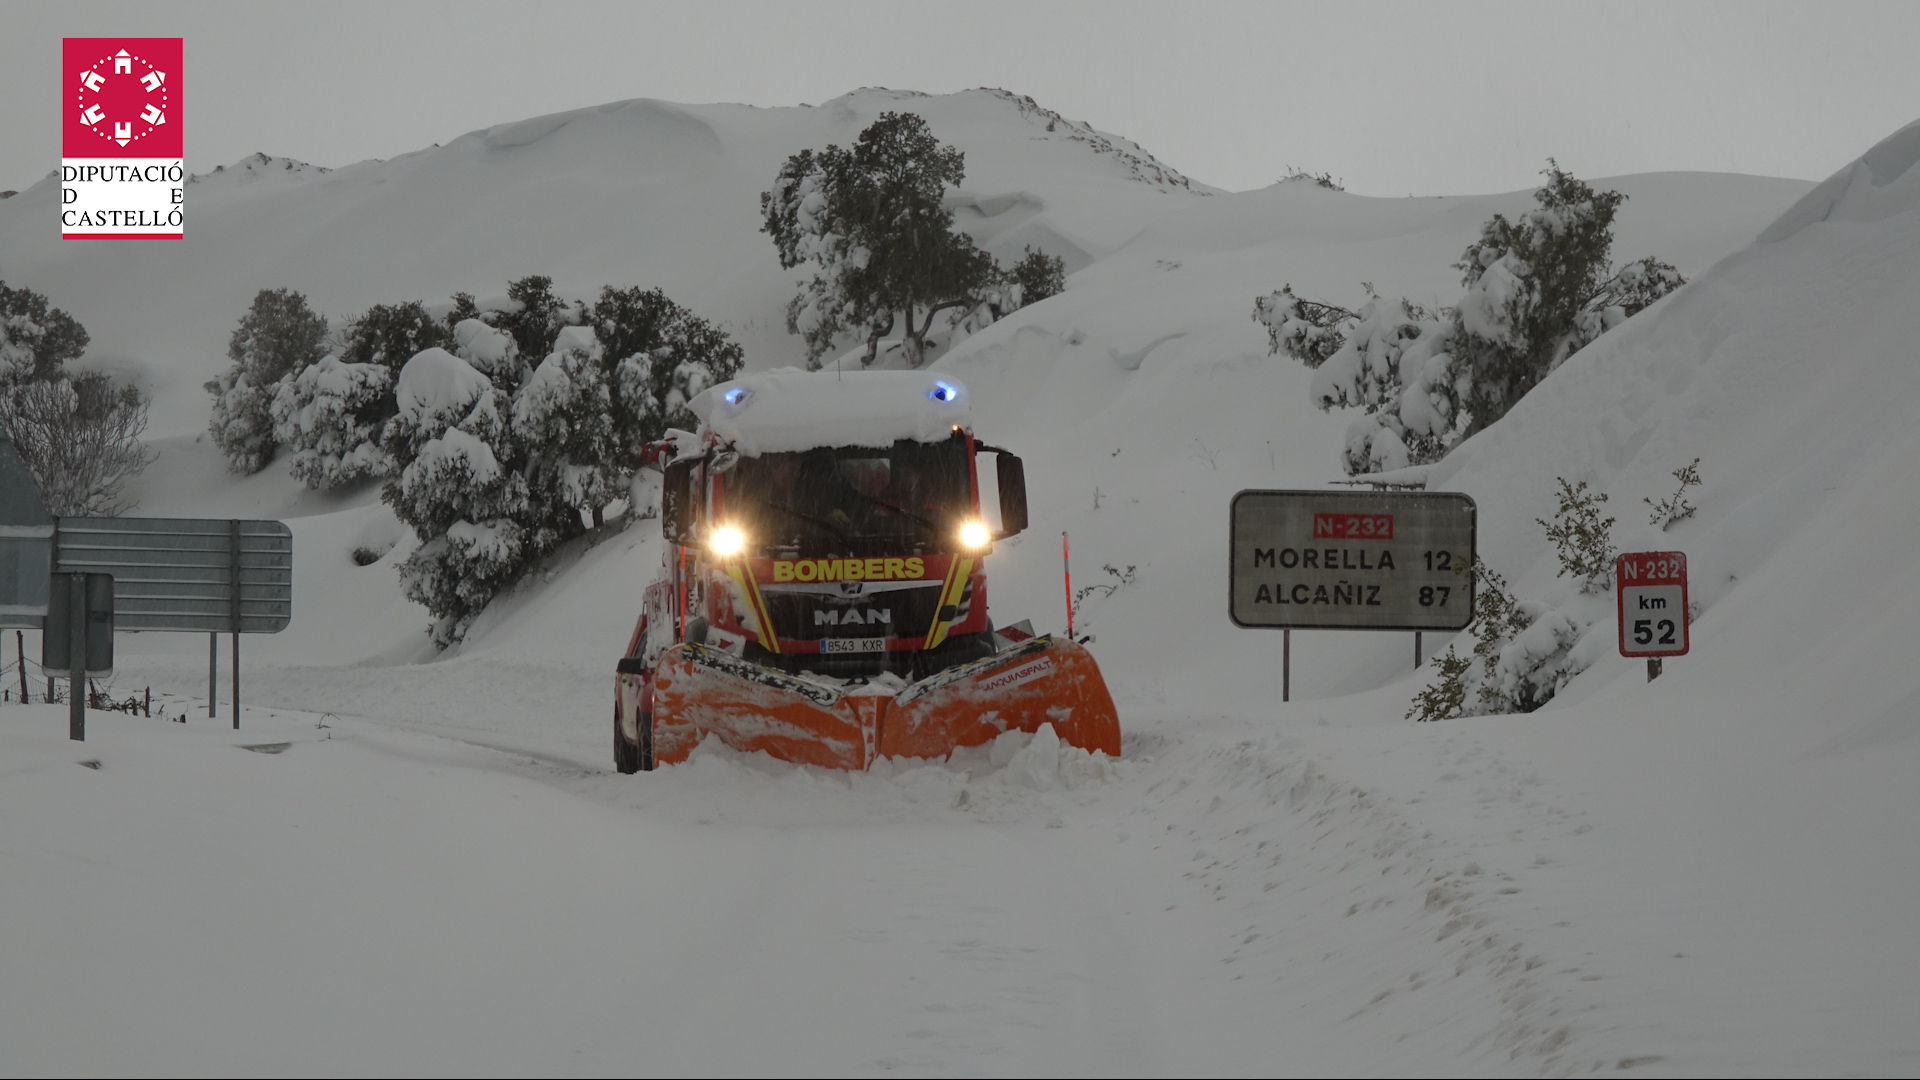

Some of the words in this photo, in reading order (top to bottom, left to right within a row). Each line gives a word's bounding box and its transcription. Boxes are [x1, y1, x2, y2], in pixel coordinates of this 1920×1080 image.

[1316, 517, 1391, 536] N-232
[774, 557, 925, 582] BOMBERS
[1254, 548, 1396, 570] MORELLA
[1423, 550, 1452, 571] 12
[1624, 560, 1680, 580] N-232
[1254, 580, 1381, 606] ALCAÑIZ
[1418, 586, 1451, 607] 87
[1639, 595, 1667, 610] km
[814, 608, 891, 626] MAN
[1634, 619, 1676, 645] 52
[827, 640, 855, 652] 8543
[862, 639, 883, 651] KXR
